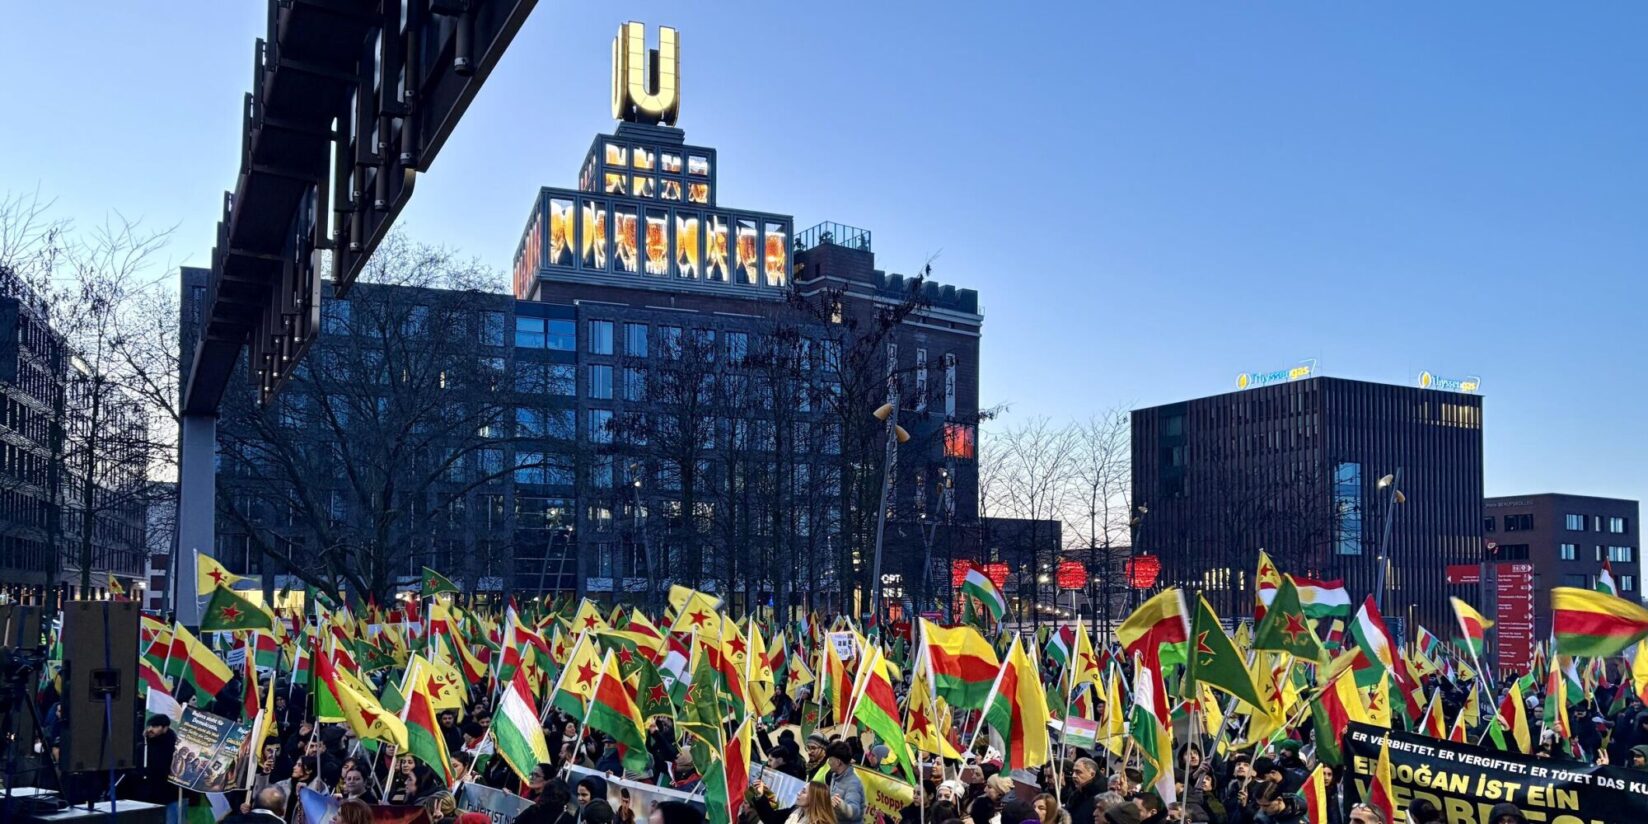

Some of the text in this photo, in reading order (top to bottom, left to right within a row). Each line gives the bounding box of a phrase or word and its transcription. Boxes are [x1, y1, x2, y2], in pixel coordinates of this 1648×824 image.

[626, 21, 680, 114] U
[1352, 731, 1368, 743] ER
[1438, 749, 1455, 761] ER
[1458, 752, 1527, 775] VERGIFTET.
[1530, 766, 1548, 778] ER
[1551, 768, 1593, 785] TÖTET
[1597, 776, 1625, 790] DAS
[876, 790, 905, 812] Stoppt
